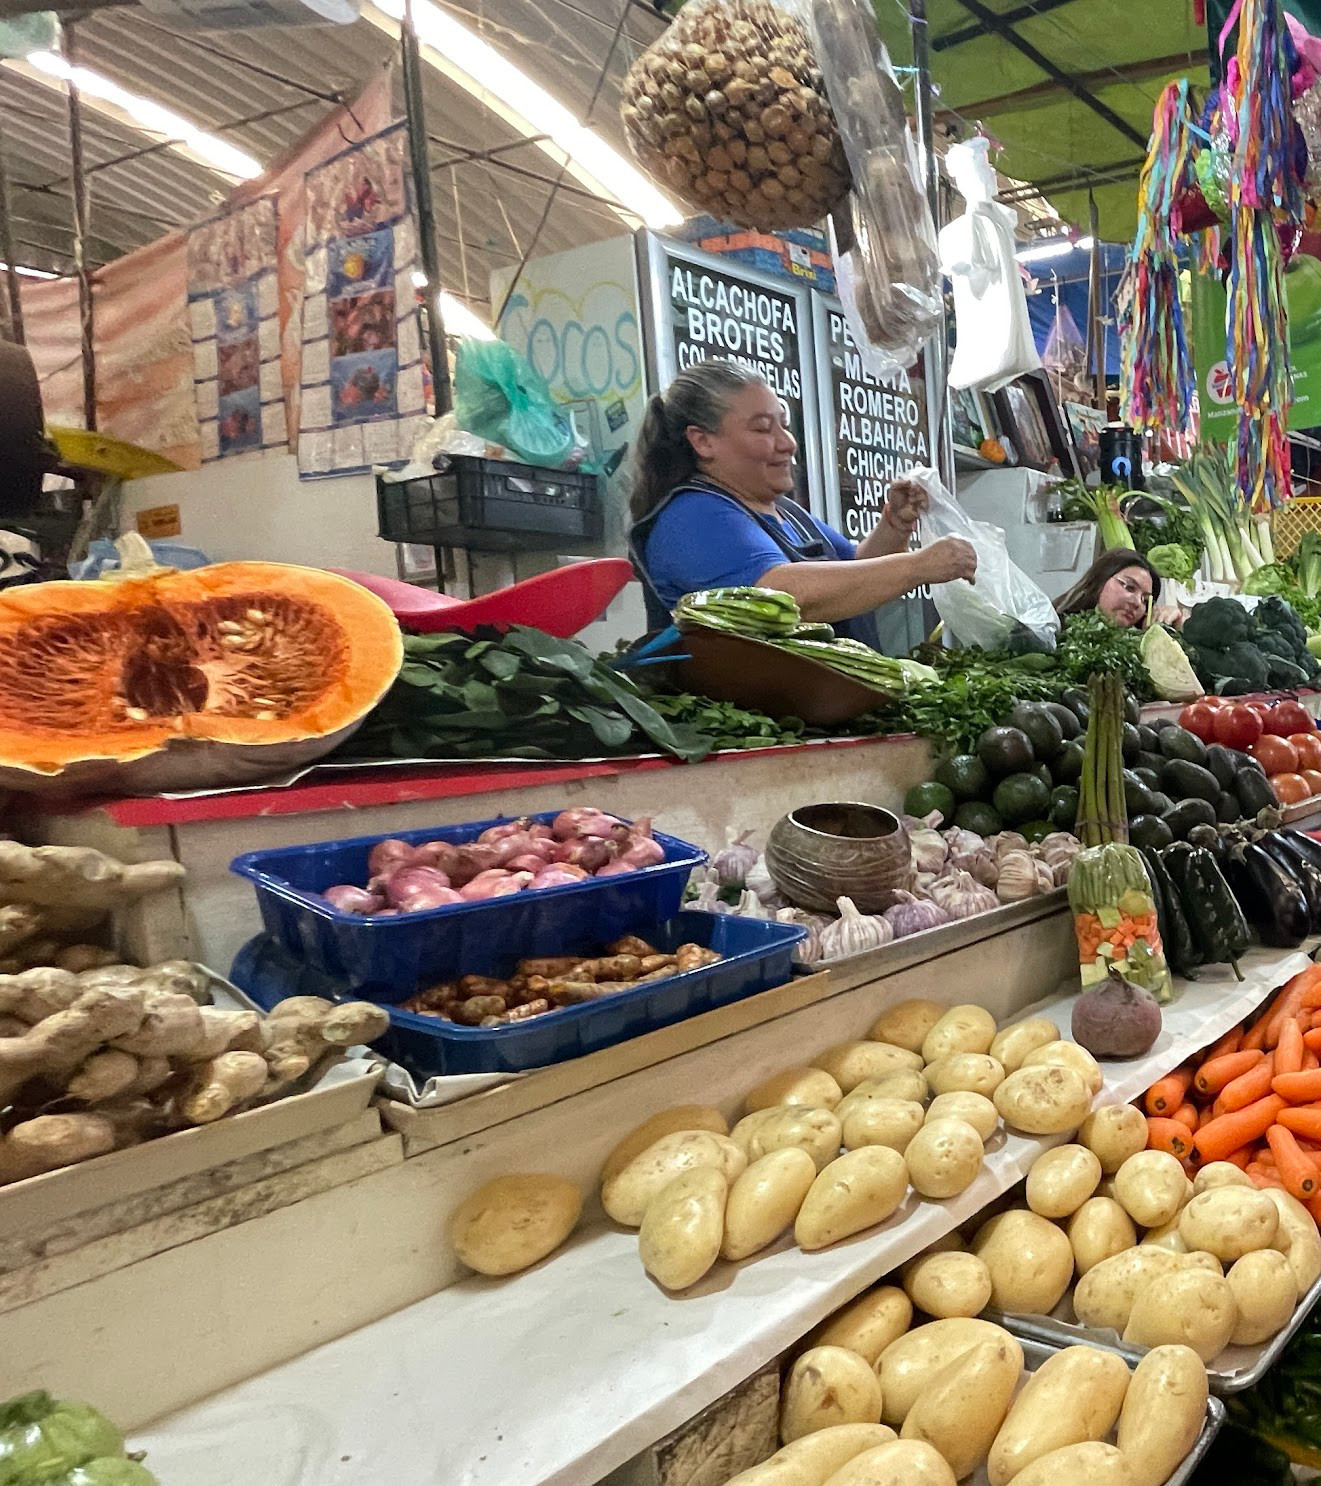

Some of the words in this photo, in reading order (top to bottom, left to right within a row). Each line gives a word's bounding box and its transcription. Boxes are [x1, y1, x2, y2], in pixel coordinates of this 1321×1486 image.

[671, 266, 796, 335] ALCACHOFA
[687, 306, 785, 363] BROTES
[728, 353, 801, 400] SELAS
[839, 381, 919, 427] ROMERO
[839, 412, 928, 458] ALBAHACA
